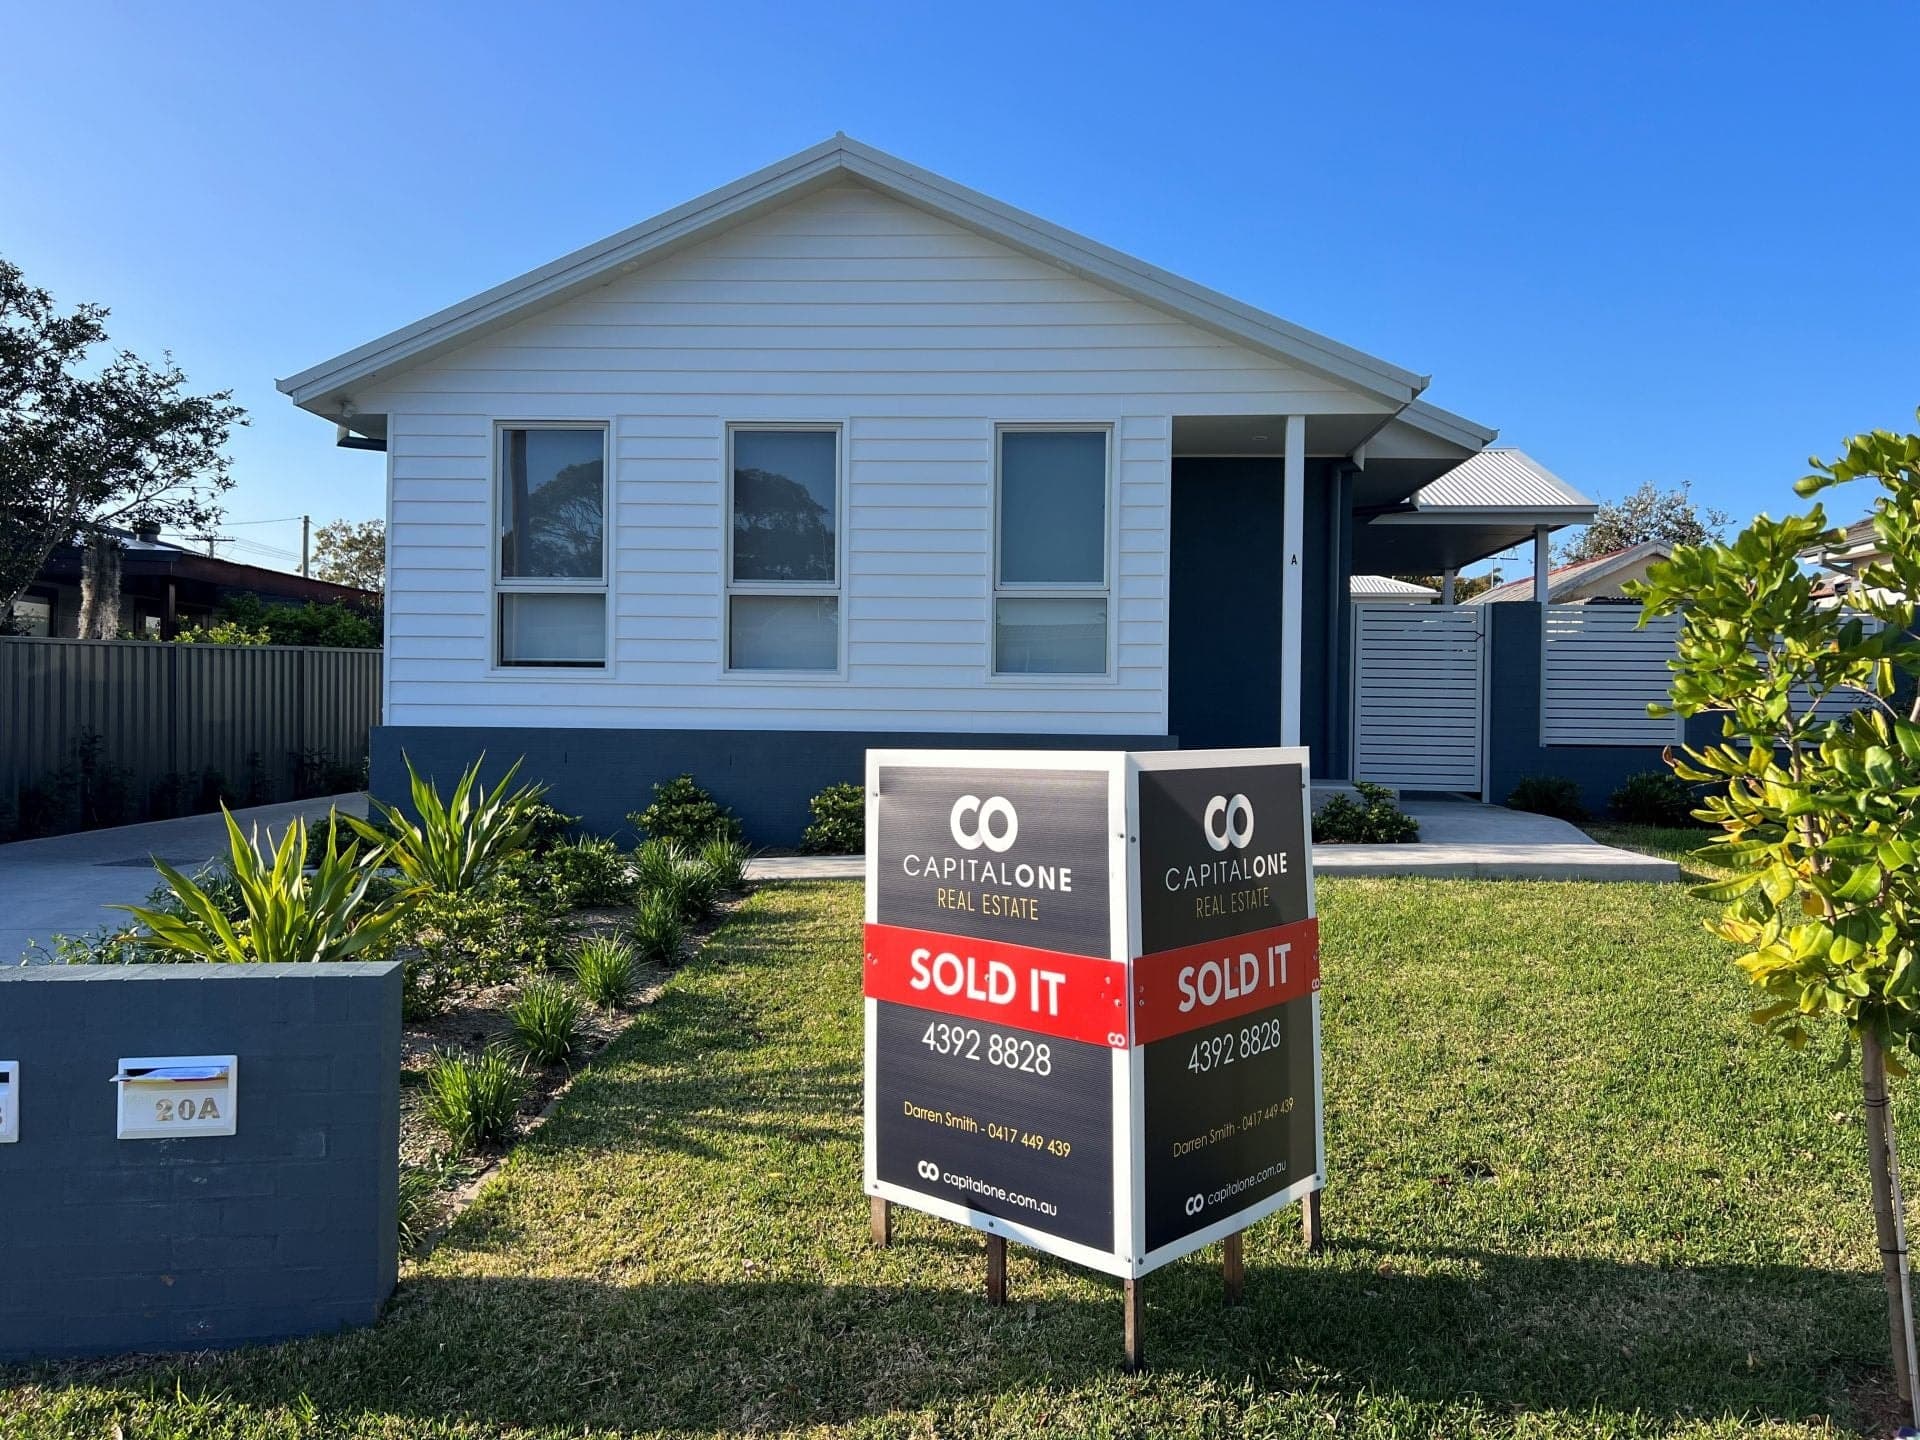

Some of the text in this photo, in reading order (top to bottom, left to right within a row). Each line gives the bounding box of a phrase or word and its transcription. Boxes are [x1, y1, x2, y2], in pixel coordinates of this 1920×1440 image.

[1290, 553, 1298, 566] A
[903, 854, 1072, 892] CAPITALONE
[1165, 852, 1288, 892] CAPITALONE
[937, 887, 1039, 921] REAL ESTATE
[1195, 886, 1270, 919] REAL ESTATE
[909, 948, 1067, 1017] SOLD IT
[1177, 942, 1292, 1013] SOLD IT
[921, 1021, 1052, 1077] 4392 8828
[1187, 1018, 1281, 1074] 4392 8828
[155, 1097, 221, 1122] 20A
[903, 1100, 943, 1125] Darren
[945, 1111, 978, 1135] Smith
[988, 1122, 1018, 1144] 0417
[1020, 1132, 1044, 1151] 449
[1047, 1139, 1072, 1158] 439
[1173, 1134, 1208, 1158] Darren
[1209, 1122, 1236, 1144] Smith
[1242, 1110, 1263, 1131] 0417
[1264, 1103, 1279, 1120] 449
[1280, 1096, 1295, 1115] 439
[943, 1171, 1058, 1217] capitalone.com.au
[1207, 1160, 1288, 1206] capitalone.com.au
